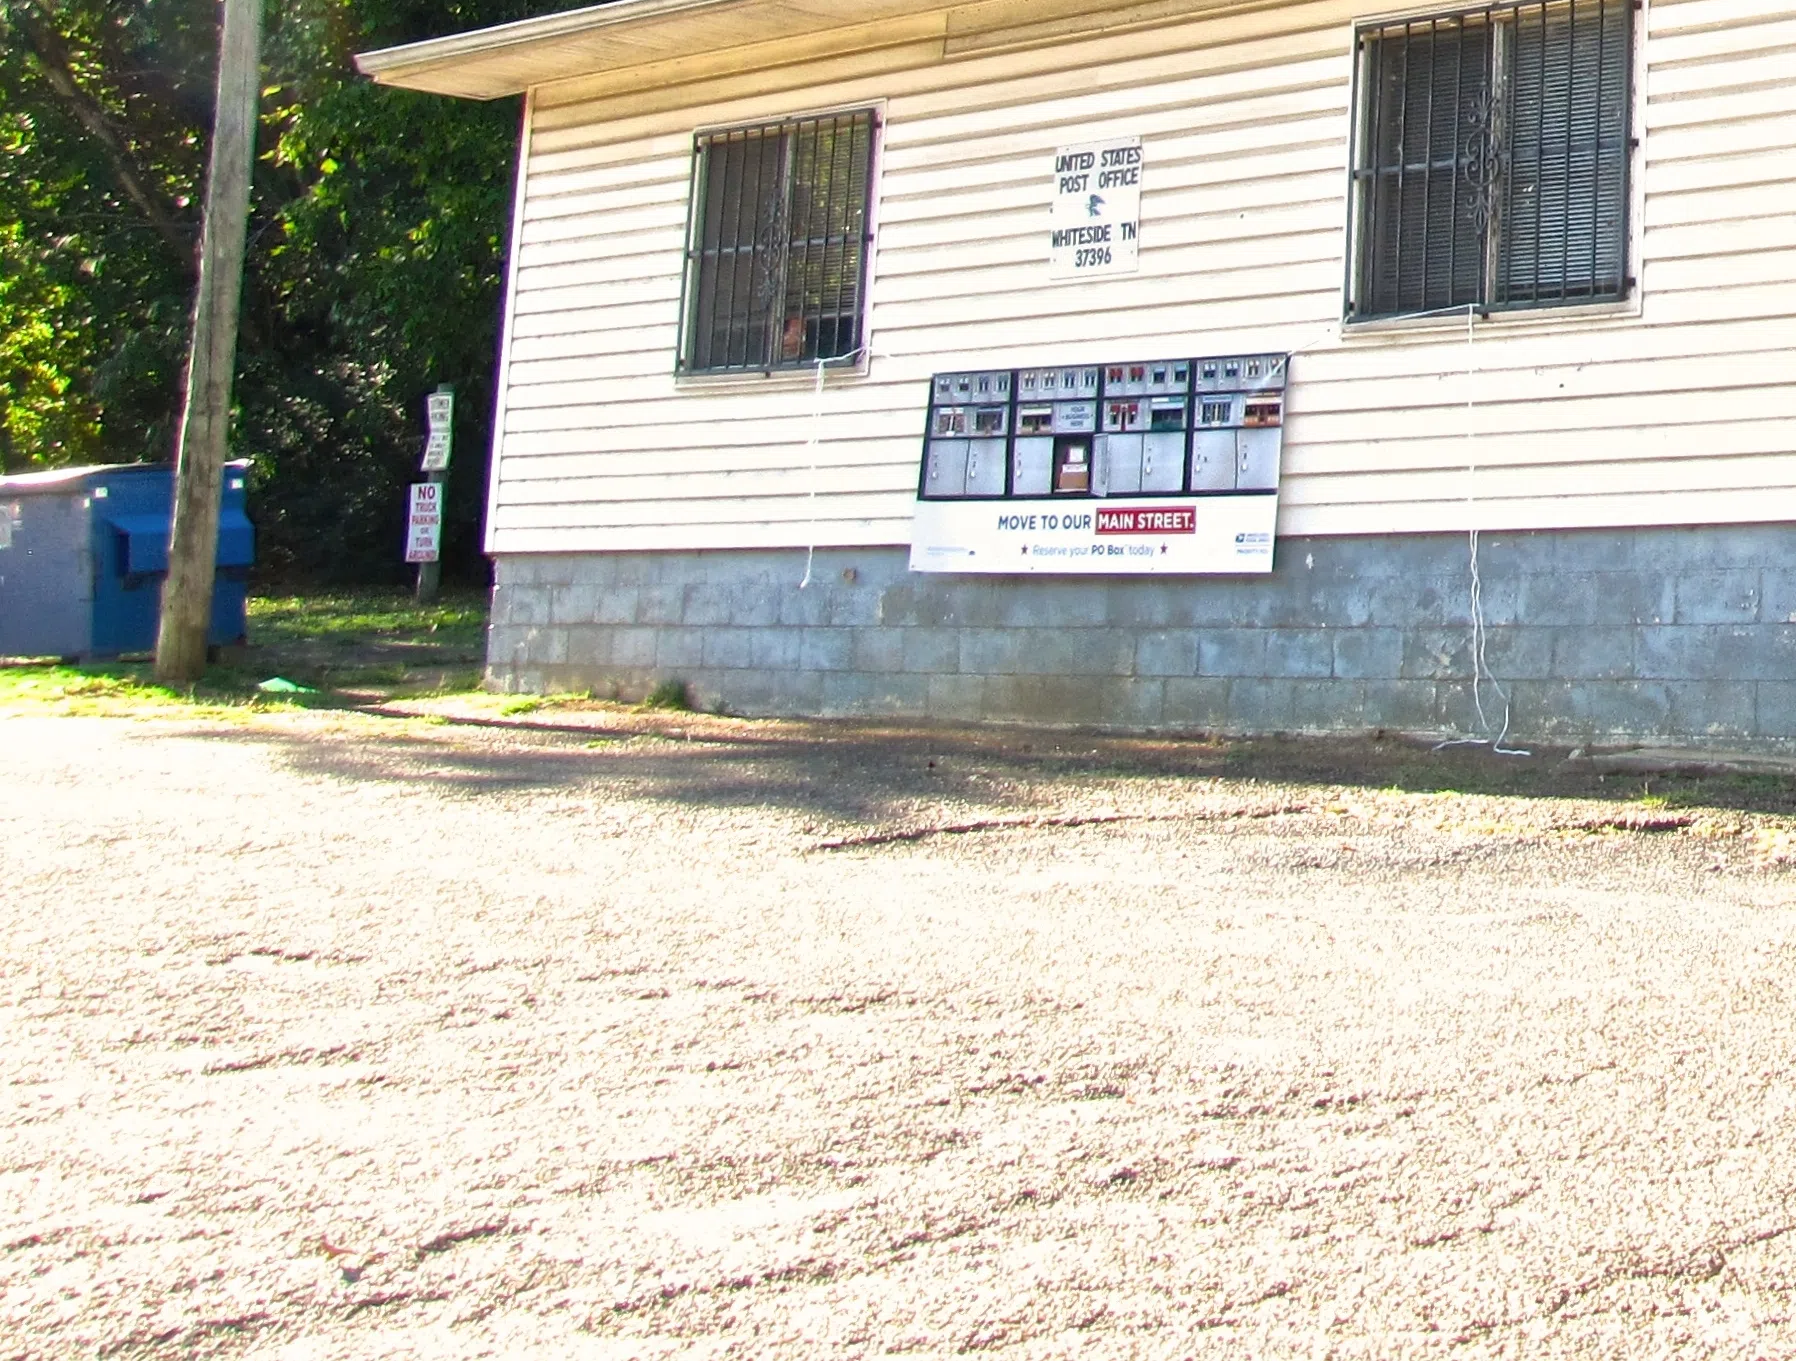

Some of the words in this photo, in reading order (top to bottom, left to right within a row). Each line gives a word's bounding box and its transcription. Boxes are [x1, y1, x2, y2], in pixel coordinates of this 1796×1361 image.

[1055, 152, 1095, 173] UNITED
[1101, 146, 1142, 167] STATES
[1060, 174, 1090, 194] POST
[1098, 167, 1139, 189] OFFICE
[1052, 224, 1112, 248] WHITESIDE
[1121, 221, 1137, 240] TN
[1075, 247, 1112, 267] 37396
[418, 486, 435, 499] NO
[415, 502, 437, 513] TRUCK
[412, 515, 439, 525] PARKING
[998, 515, 1037, 530] MOVE
[1041, 514, 1059, 530] TO
[1062, 514, 1092, 529] OUR
[1098, 513, 1134, 529] MAIN
[1137, 512, 1194, 529] STREET.
[416, 537, 433, 547] TURN
[1033, 544, 1067, 556] Reserve
[1070, 546, 1088, 558] your
[1091, 544, 1105, 555] PO
[1129, 544, 1155, 558] today
